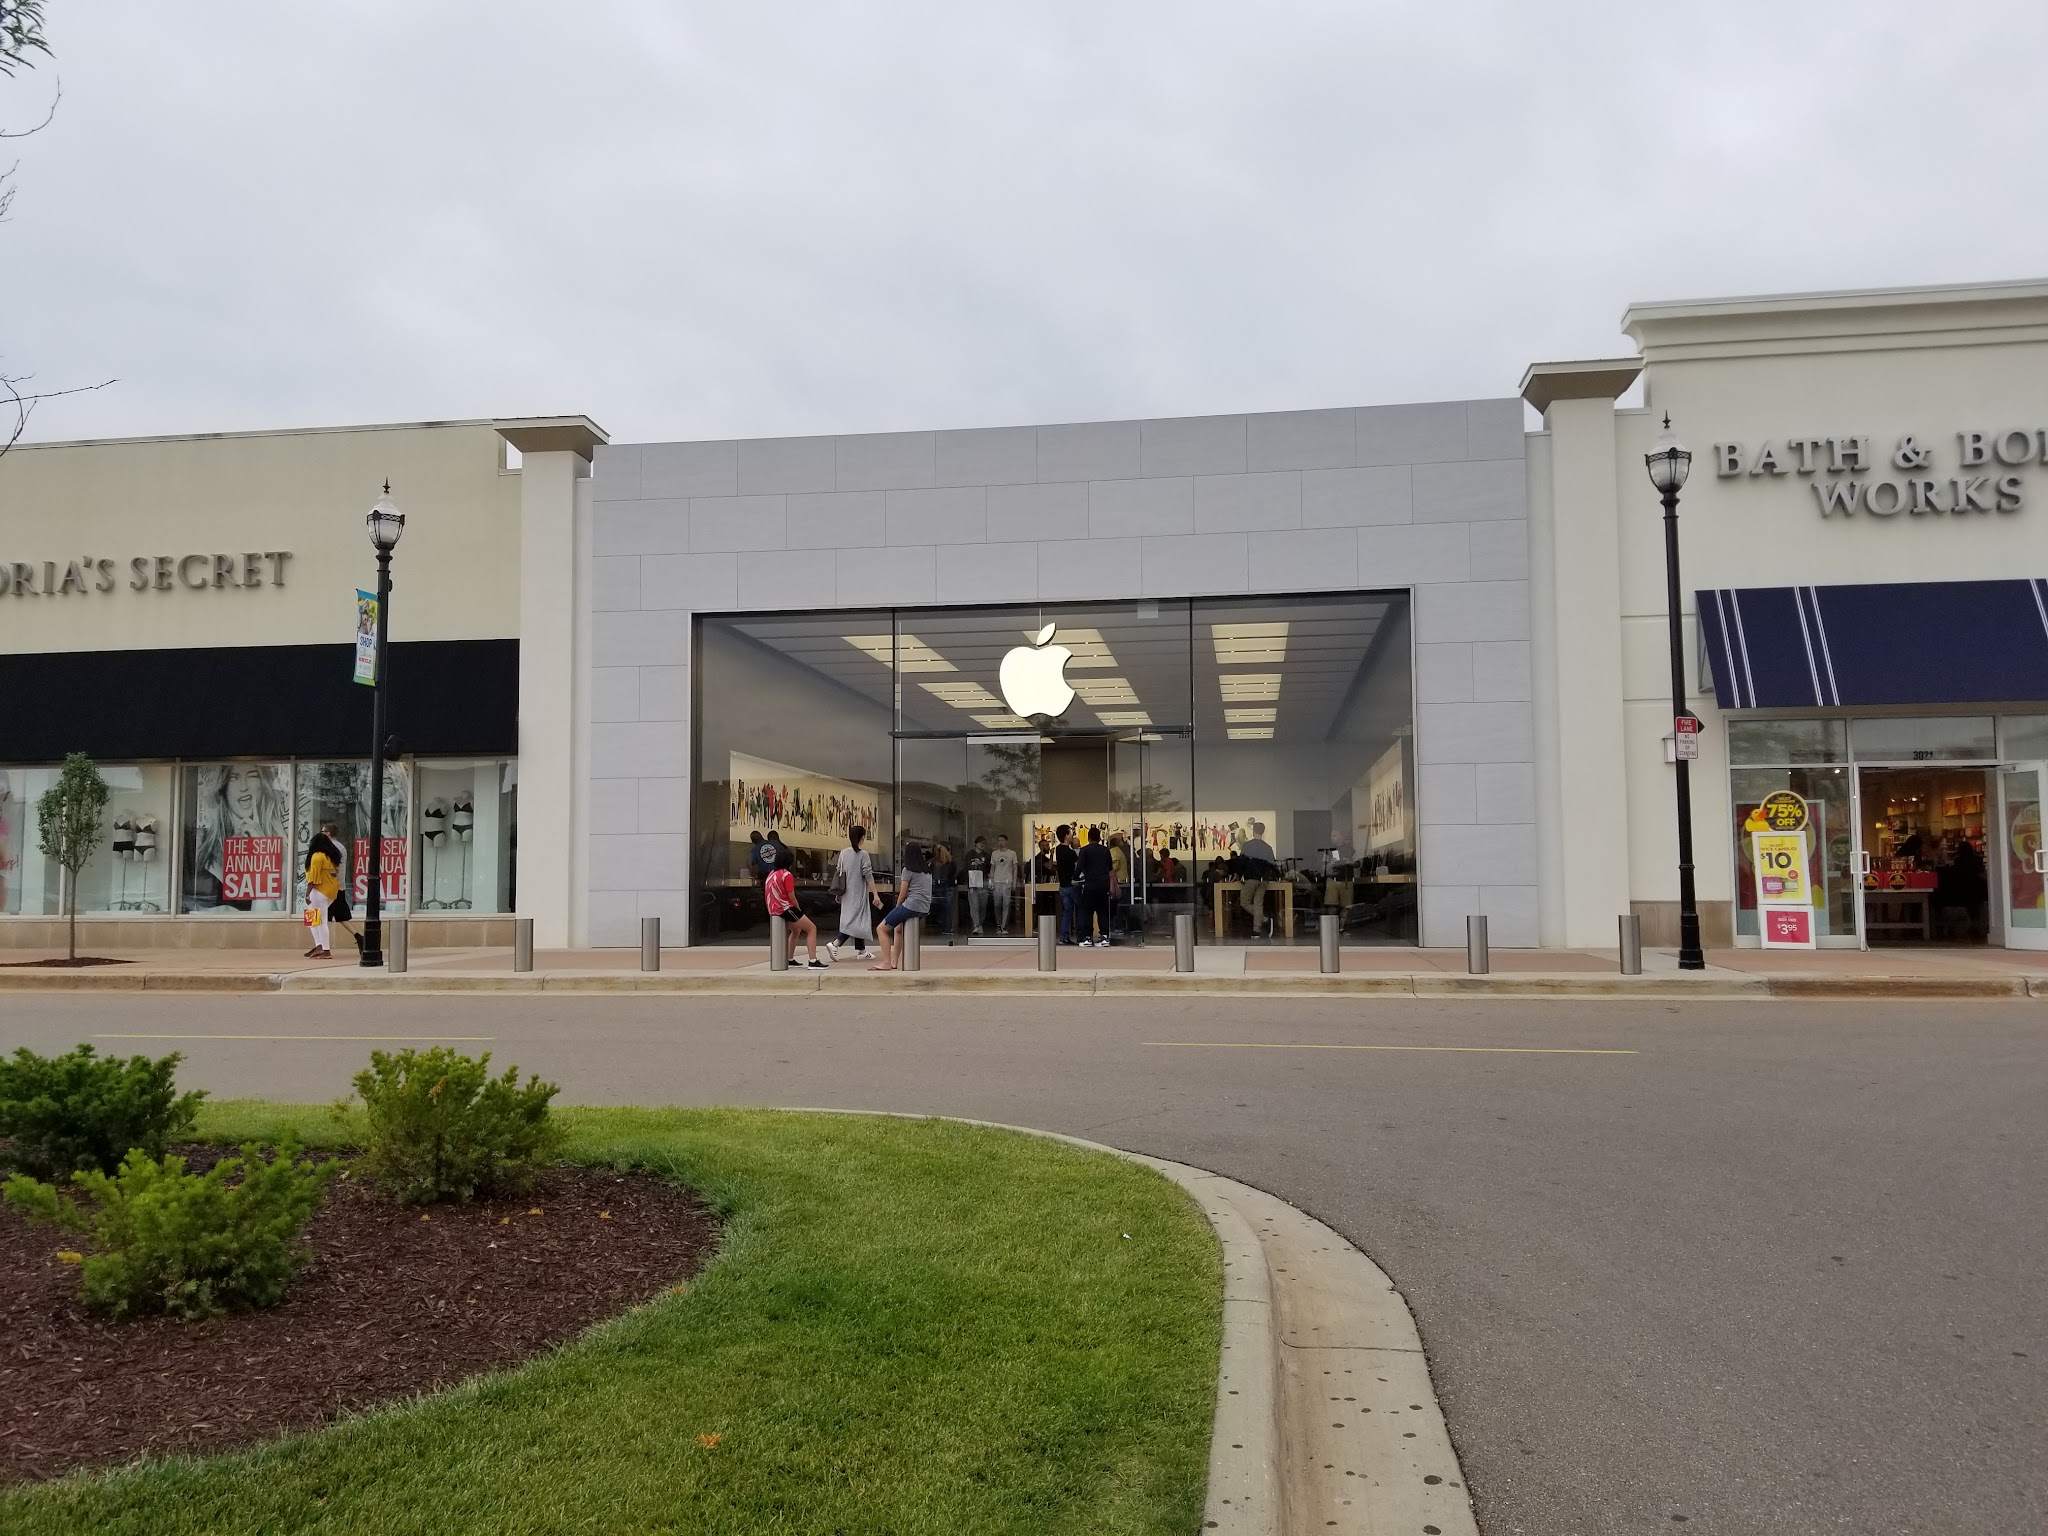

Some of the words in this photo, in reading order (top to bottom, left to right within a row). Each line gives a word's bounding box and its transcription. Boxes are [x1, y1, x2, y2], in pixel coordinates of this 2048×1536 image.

[1713, 434, 1871, 478] BATH
[1892, 433, 1932, 470] &
[1956, 427, 2048, 467] BO
[1811, 475, 2025, 518] WORKS
[130, 551, 293, 591] SECRET
[360, 636, 373, 648] SHOP
[1766, 803, 1803, 818] 75%
[1776, 818, 1796, 826] OFF
[226, 839, 249, 855] THE
[252, 838, 281, 854] SEMI
[356, 840, 370, 856] TH
[383, 840, 408, 855] SEM
[225, 855, 280, 873] ANNUAL
[355, 856, 407, 874] AUA
[1760, 852, 1792, 869] $10
[224, 873, 281, 898] SALE
